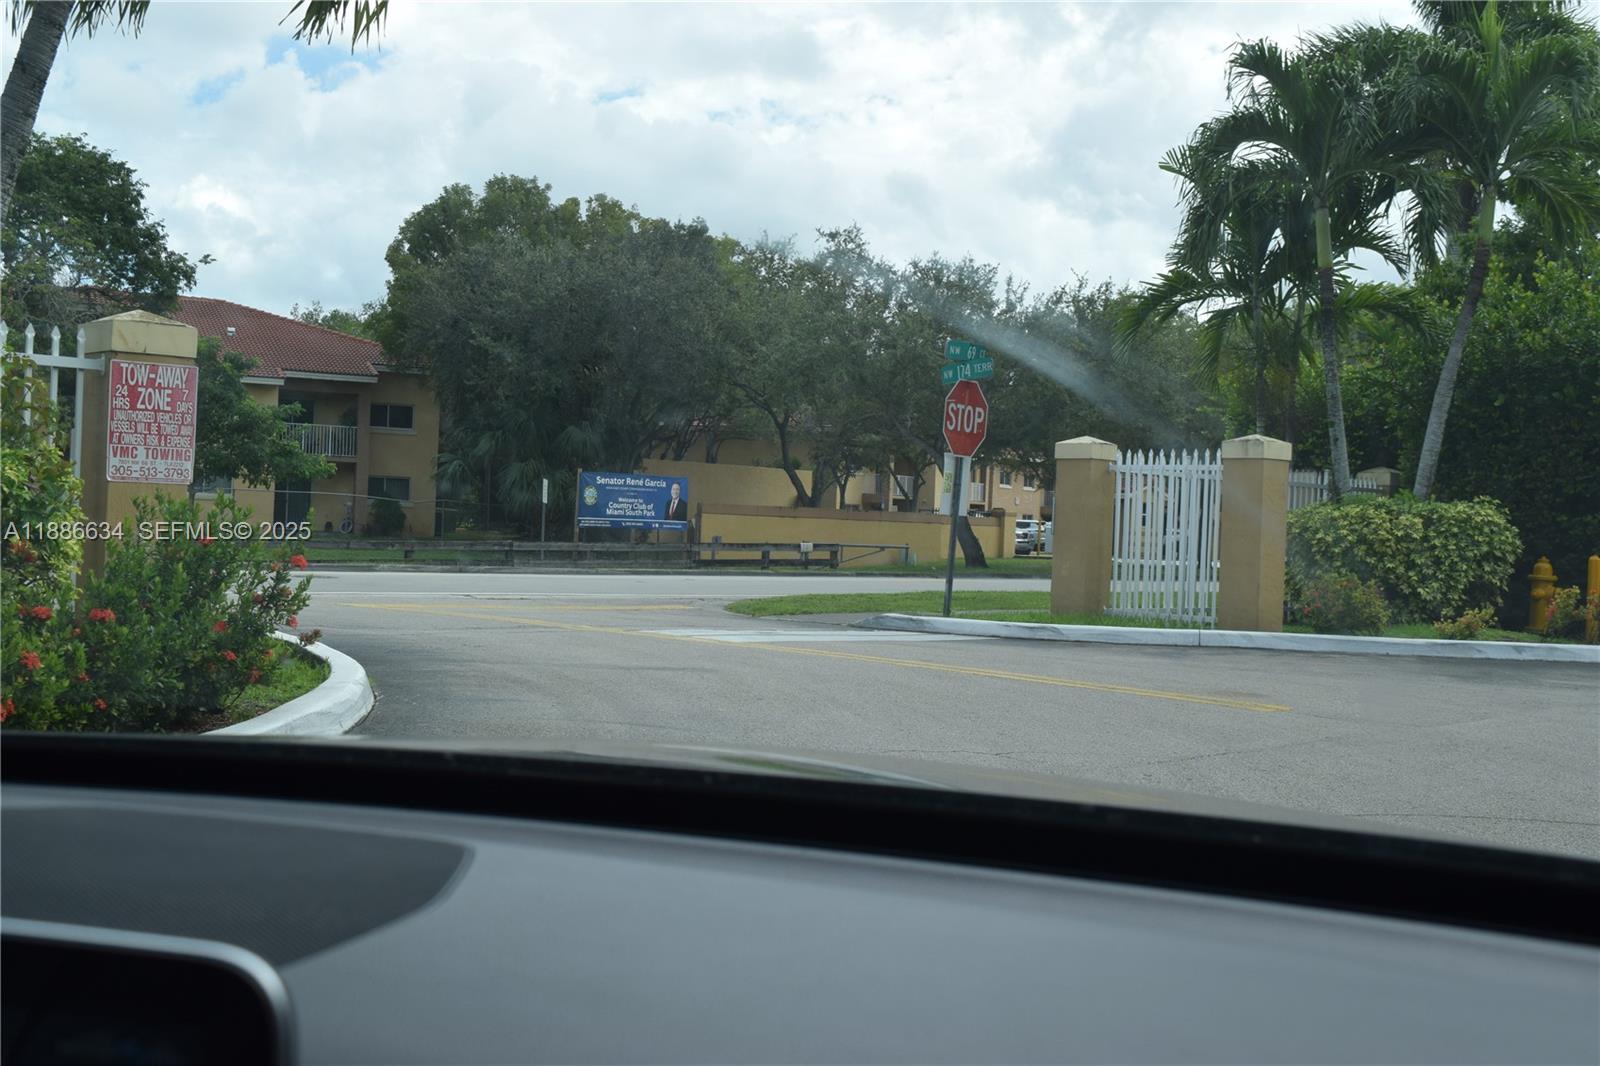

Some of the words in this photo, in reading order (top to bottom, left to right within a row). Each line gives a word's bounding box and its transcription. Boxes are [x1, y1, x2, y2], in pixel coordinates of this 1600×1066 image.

[949, 345, 961, 355] NW
[967, 345, 977, 360] 69
[120, 363, 189, 389] TOW-AWAY
[943, 370, 953, 379] NW
[956, 364, 971, 379] 174
[974, 362, 993, 373] TERR
[115, 385, 128, 396] 24
[182, 390, 189, 401] 7
[112, 397, 130, 410] HRS
[136, 387, 172, 411] ZONE
[176, 402, 193, 413] DAYS
[113, 411, 155, 423] UNAUTHORIZED
[156, 412, 182, 425] VEHICLES
[183, 414, 192, 424] OR
[946, 402, 985, 434] STOP
[111, 421, 135, 433] VESSELS
[136, 422, 149, 434] WILL
[150, 423, 159, 434] BE
[160, 423, 178, 436] TOWED
[111, 433, 119, 444] AT
[145, 434, 159, 446] RISK
[166, 436, 191, 448] EXPENSE
[111, 446, 138, 459] VMC
[145, 447, 191, 461] TOWING
[110, 465, 190, 479] 305-513-3793
[596, 476, 625, 485] Senator
[626, 477, 643, 486] René
[606, 508, 624, 516] Miami
[625, 509, 642, 517] South
[643, 509, 655, 517] Park
[608, 502, 632, 510] Country
[633, 502, 646, 510] Club
